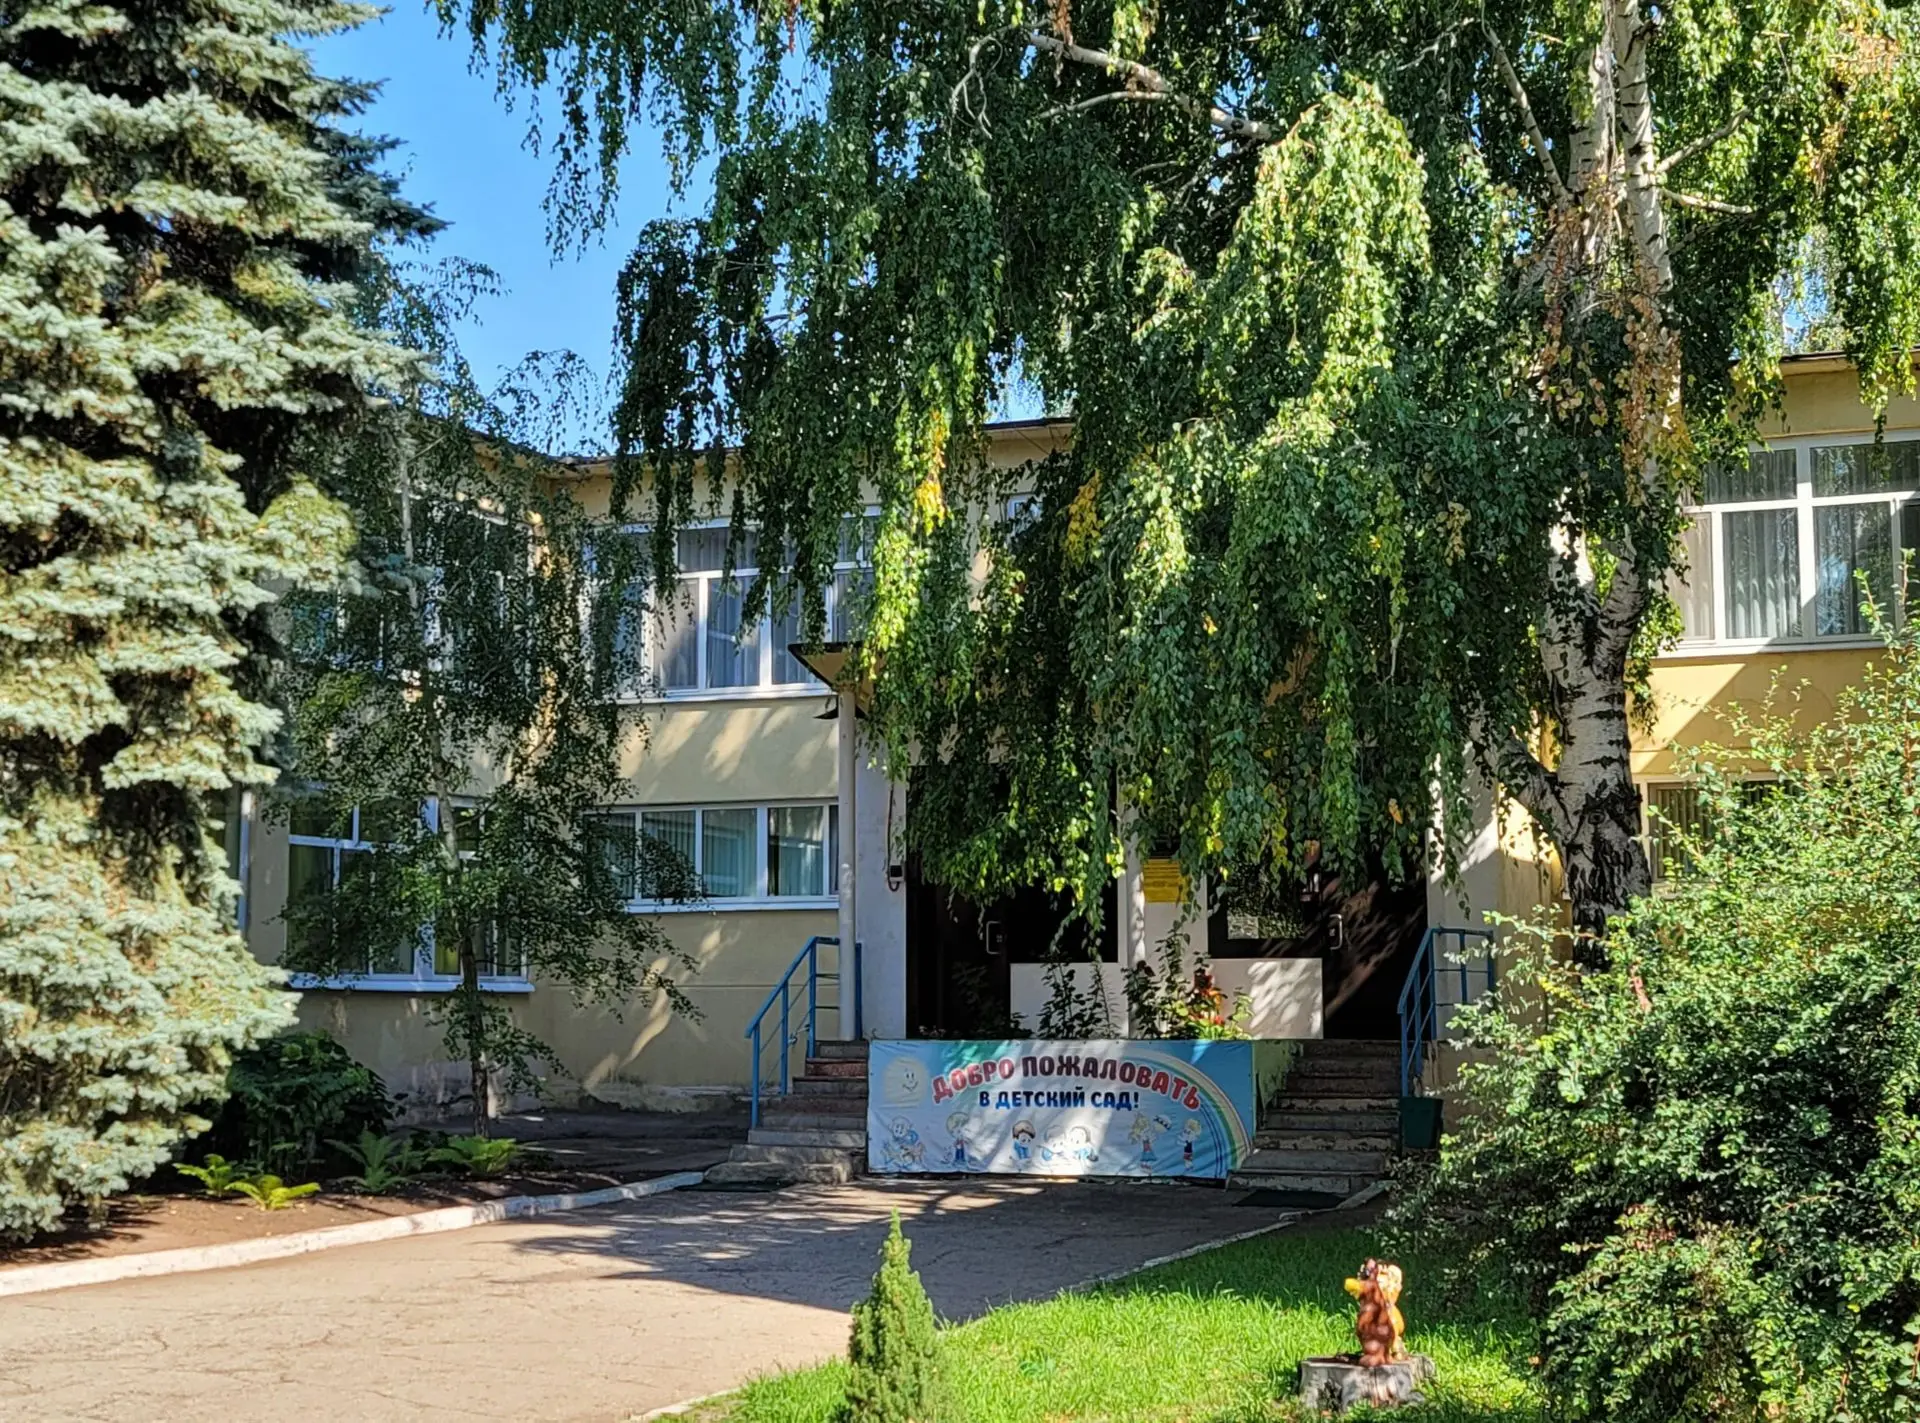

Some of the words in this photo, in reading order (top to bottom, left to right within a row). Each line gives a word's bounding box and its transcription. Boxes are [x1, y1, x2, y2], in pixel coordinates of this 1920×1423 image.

[932, 1058, 1015, 1104] ДОБРО
[1021, 1055, 1200, 1110] ПОЖАЛОВАТЬ
[979, 1090, 990, 1107] В
[995, 1086, 1085, 1110] ДЕТСКИЙ
[1091, 1091, 1139, 1111] САД!
